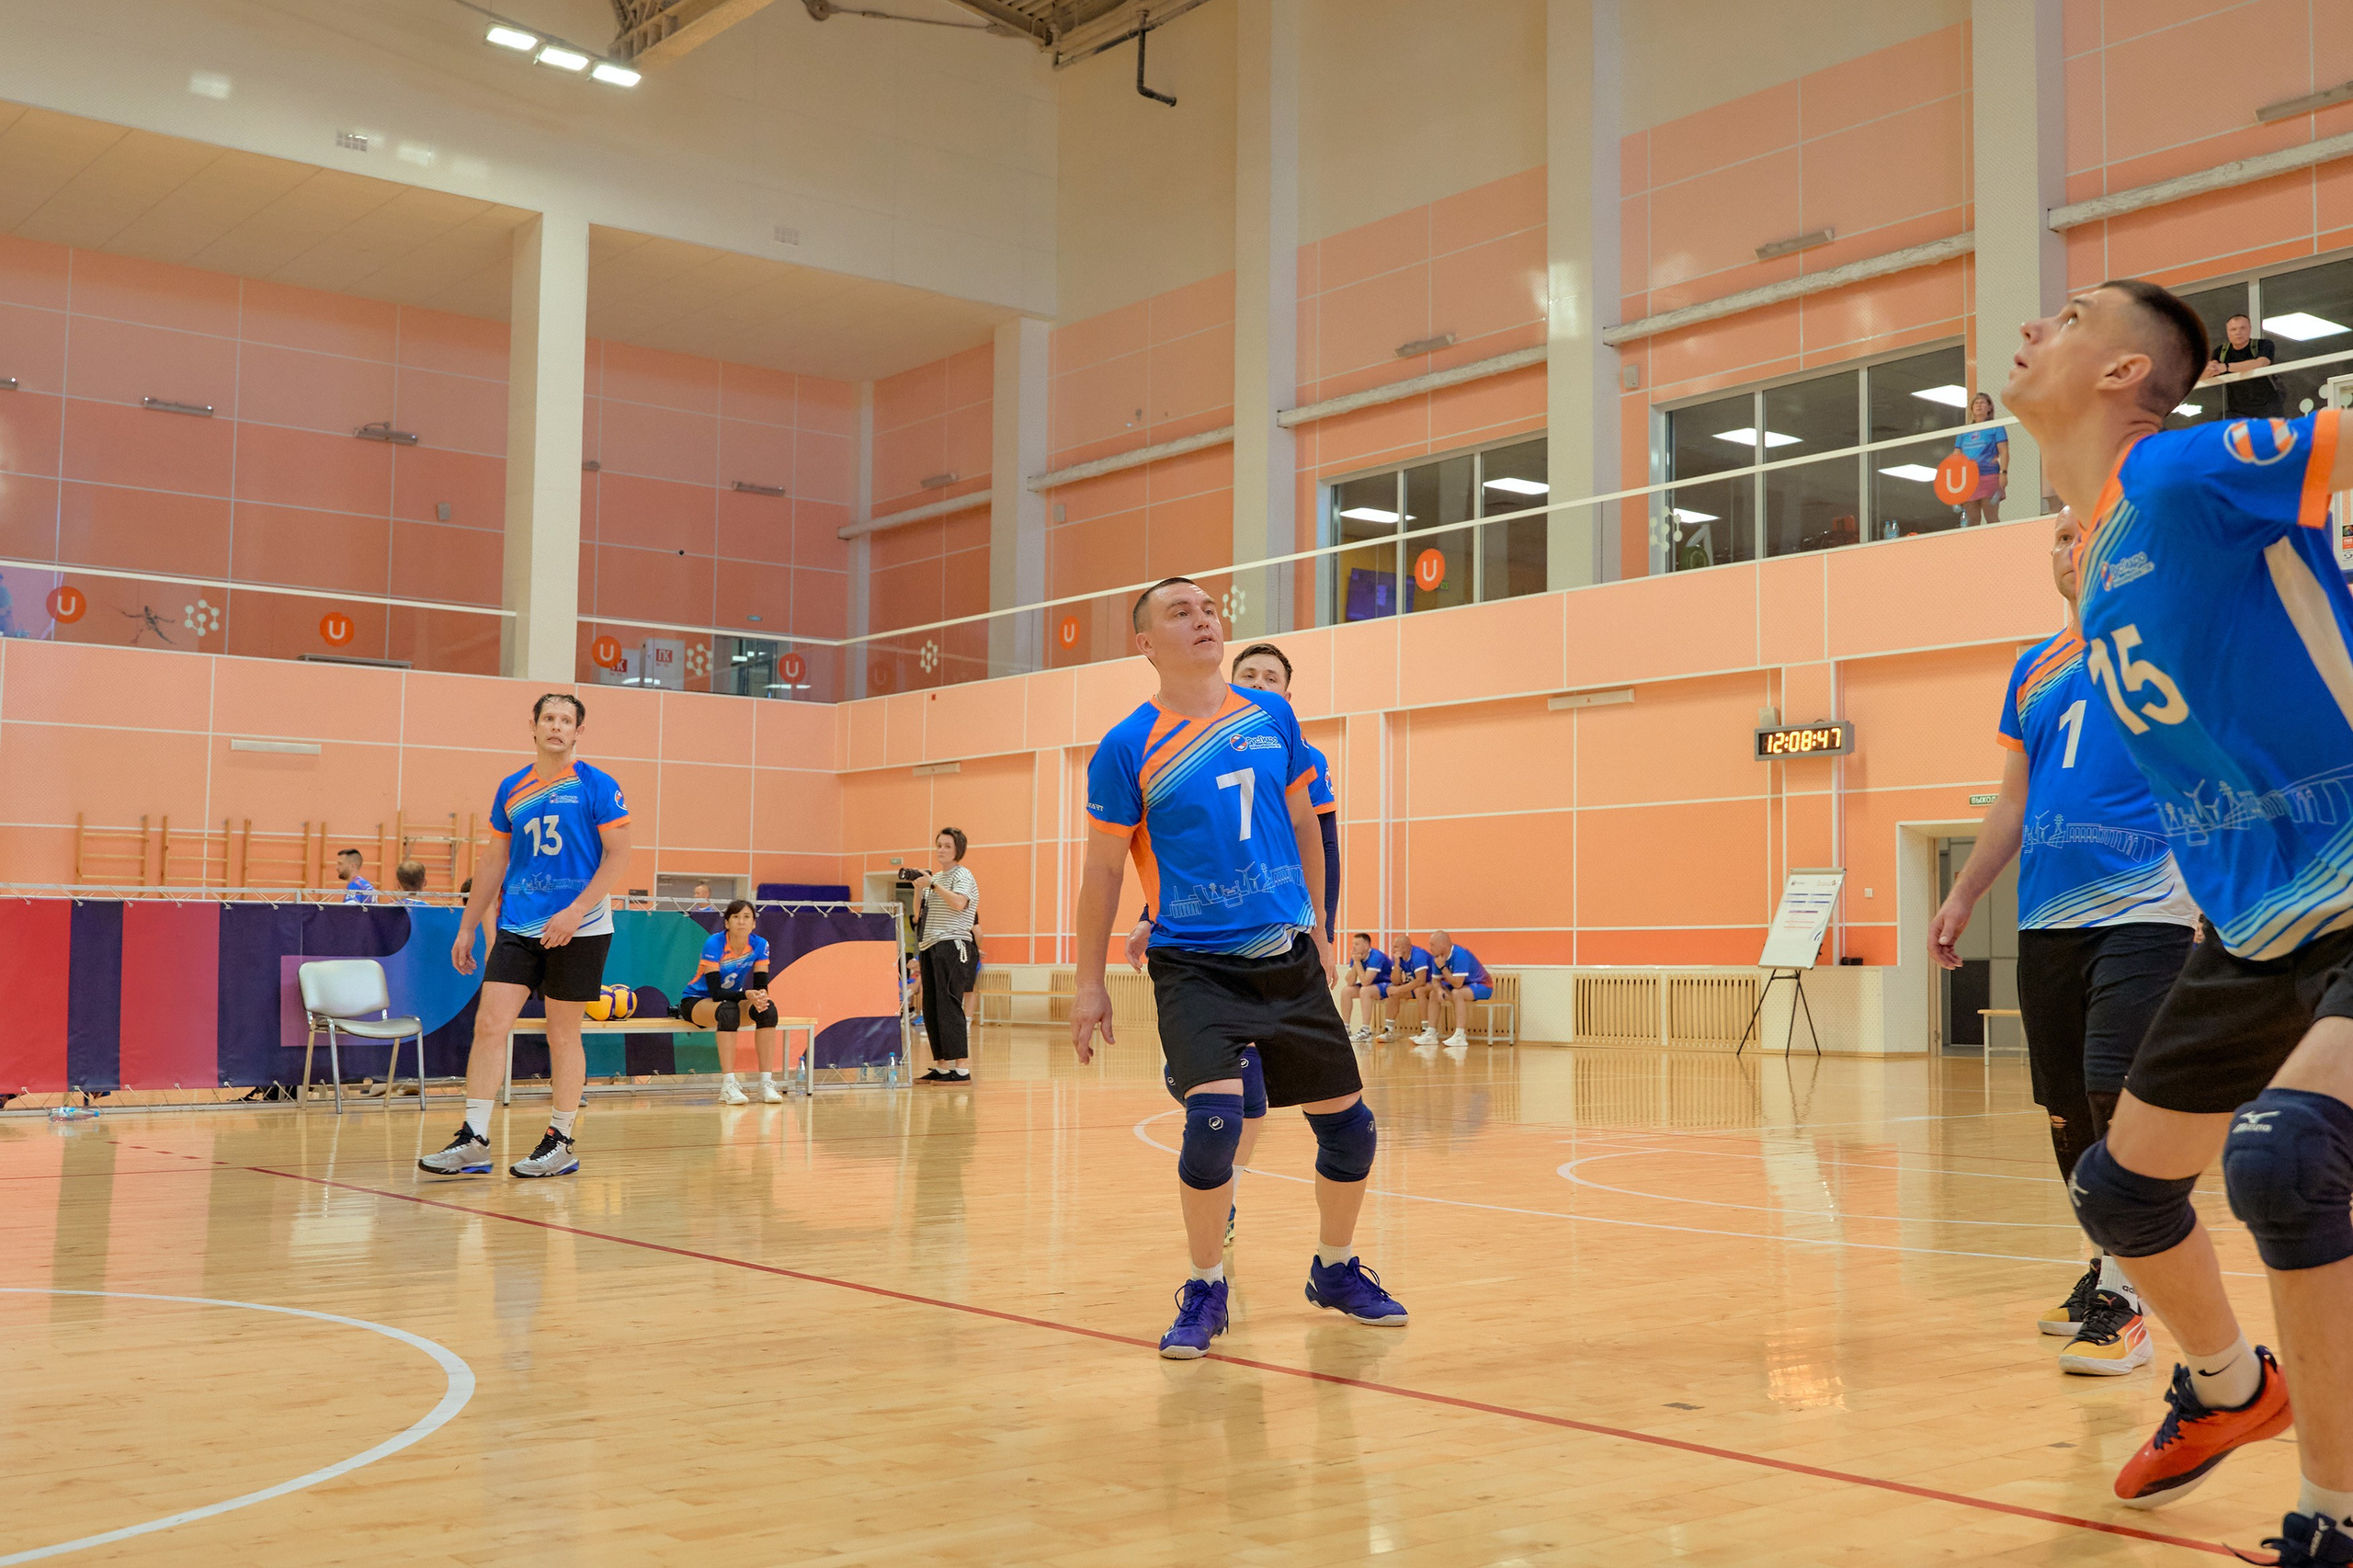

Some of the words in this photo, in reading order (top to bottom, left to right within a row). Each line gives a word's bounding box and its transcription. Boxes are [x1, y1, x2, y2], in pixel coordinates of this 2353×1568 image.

[2087, 623, 2189, 735] 15
[1768, 727, 1841, 754] 12:08:47
[2059, 699, 2087, 768] 1
[523, 814, 563, 857] 13
[1215, 767, 1256, 841] 7
